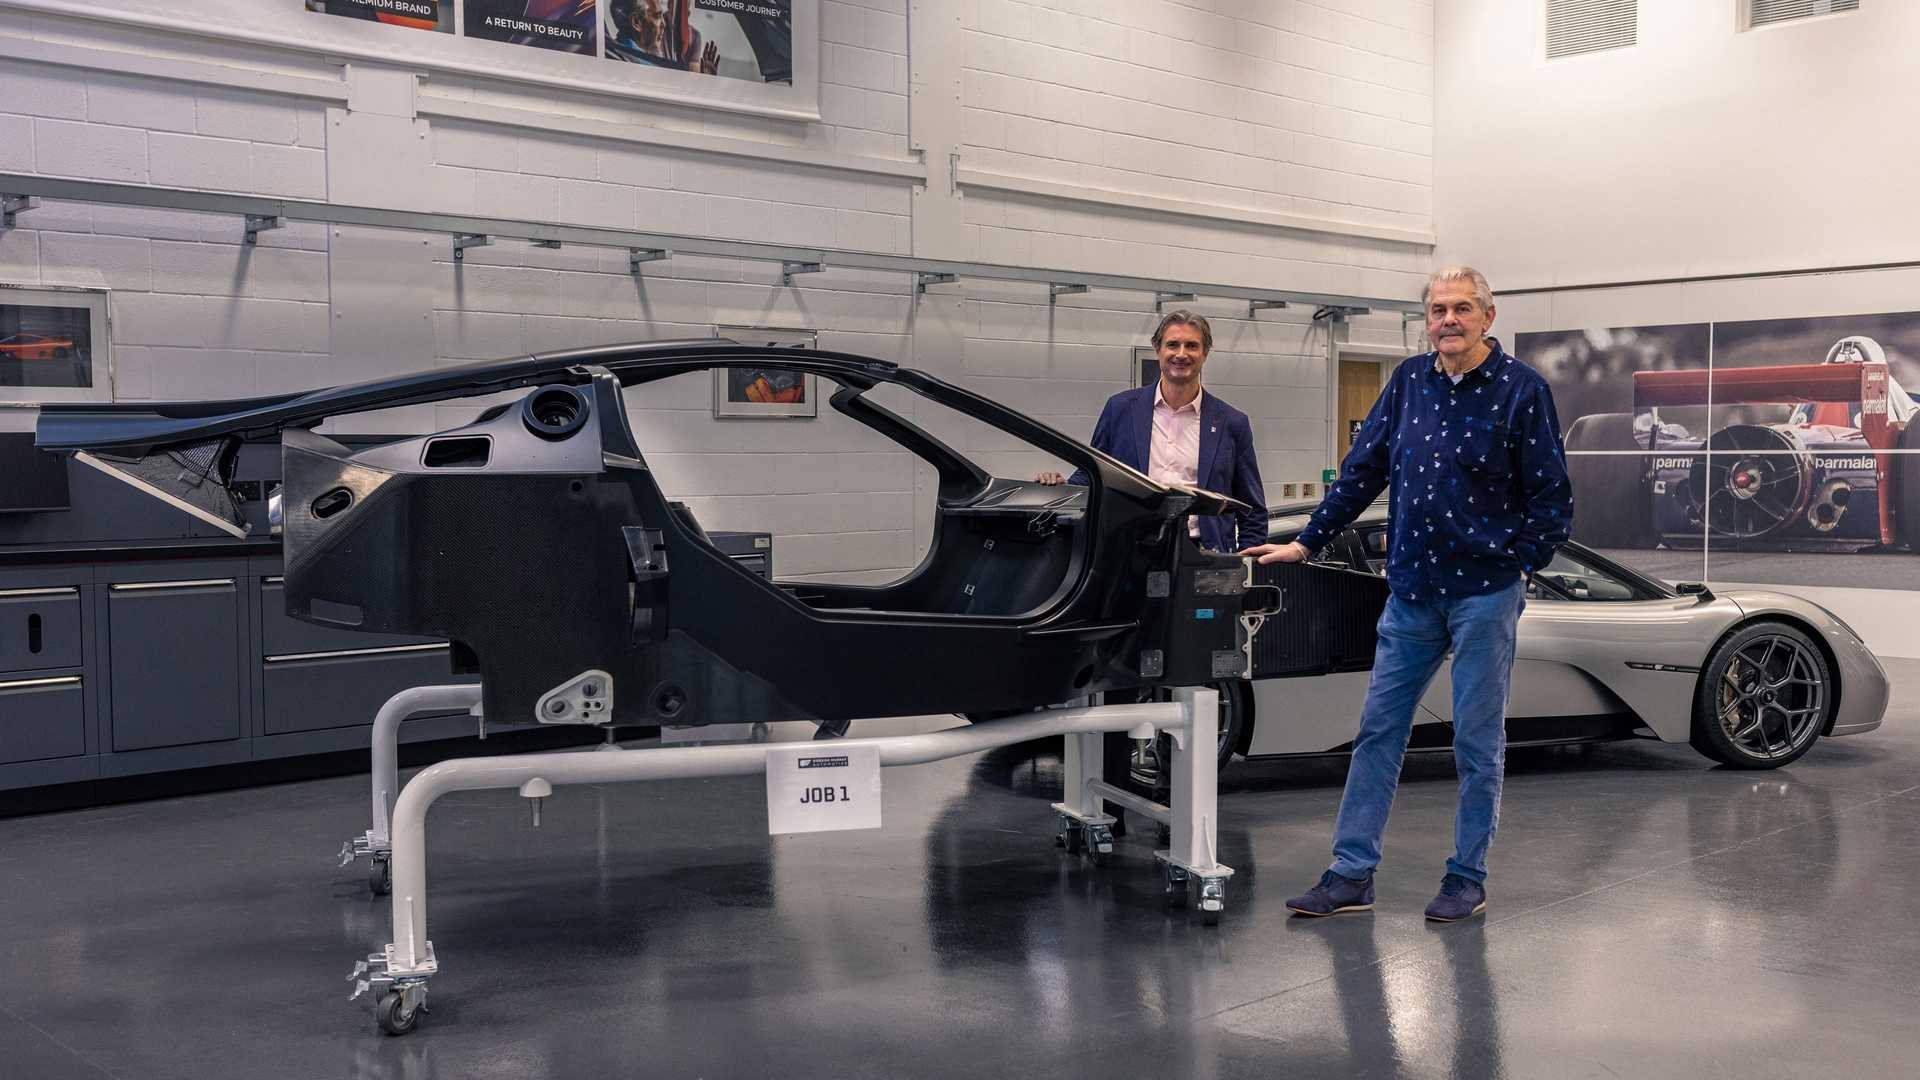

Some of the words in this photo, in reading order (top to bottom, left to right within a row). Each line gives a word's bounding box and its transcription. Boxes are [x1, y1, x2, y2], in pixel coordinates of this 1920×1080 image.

[352, 0, 393, 8] EMIUM
[395, 1, 431, 15] BRAND
[745, 5, 781, 17] JOURNEY
[485, 16, 493, 25] A
[494, 17, 532, 31] RETURN
[533, 24, 546, 34] TO
[548, 26, 583, 40] BEAUTY
[1655, 457, 1694, 470] parm
[800, 787, 835, 803] JOB
[840, 786, 850, 801] 1
